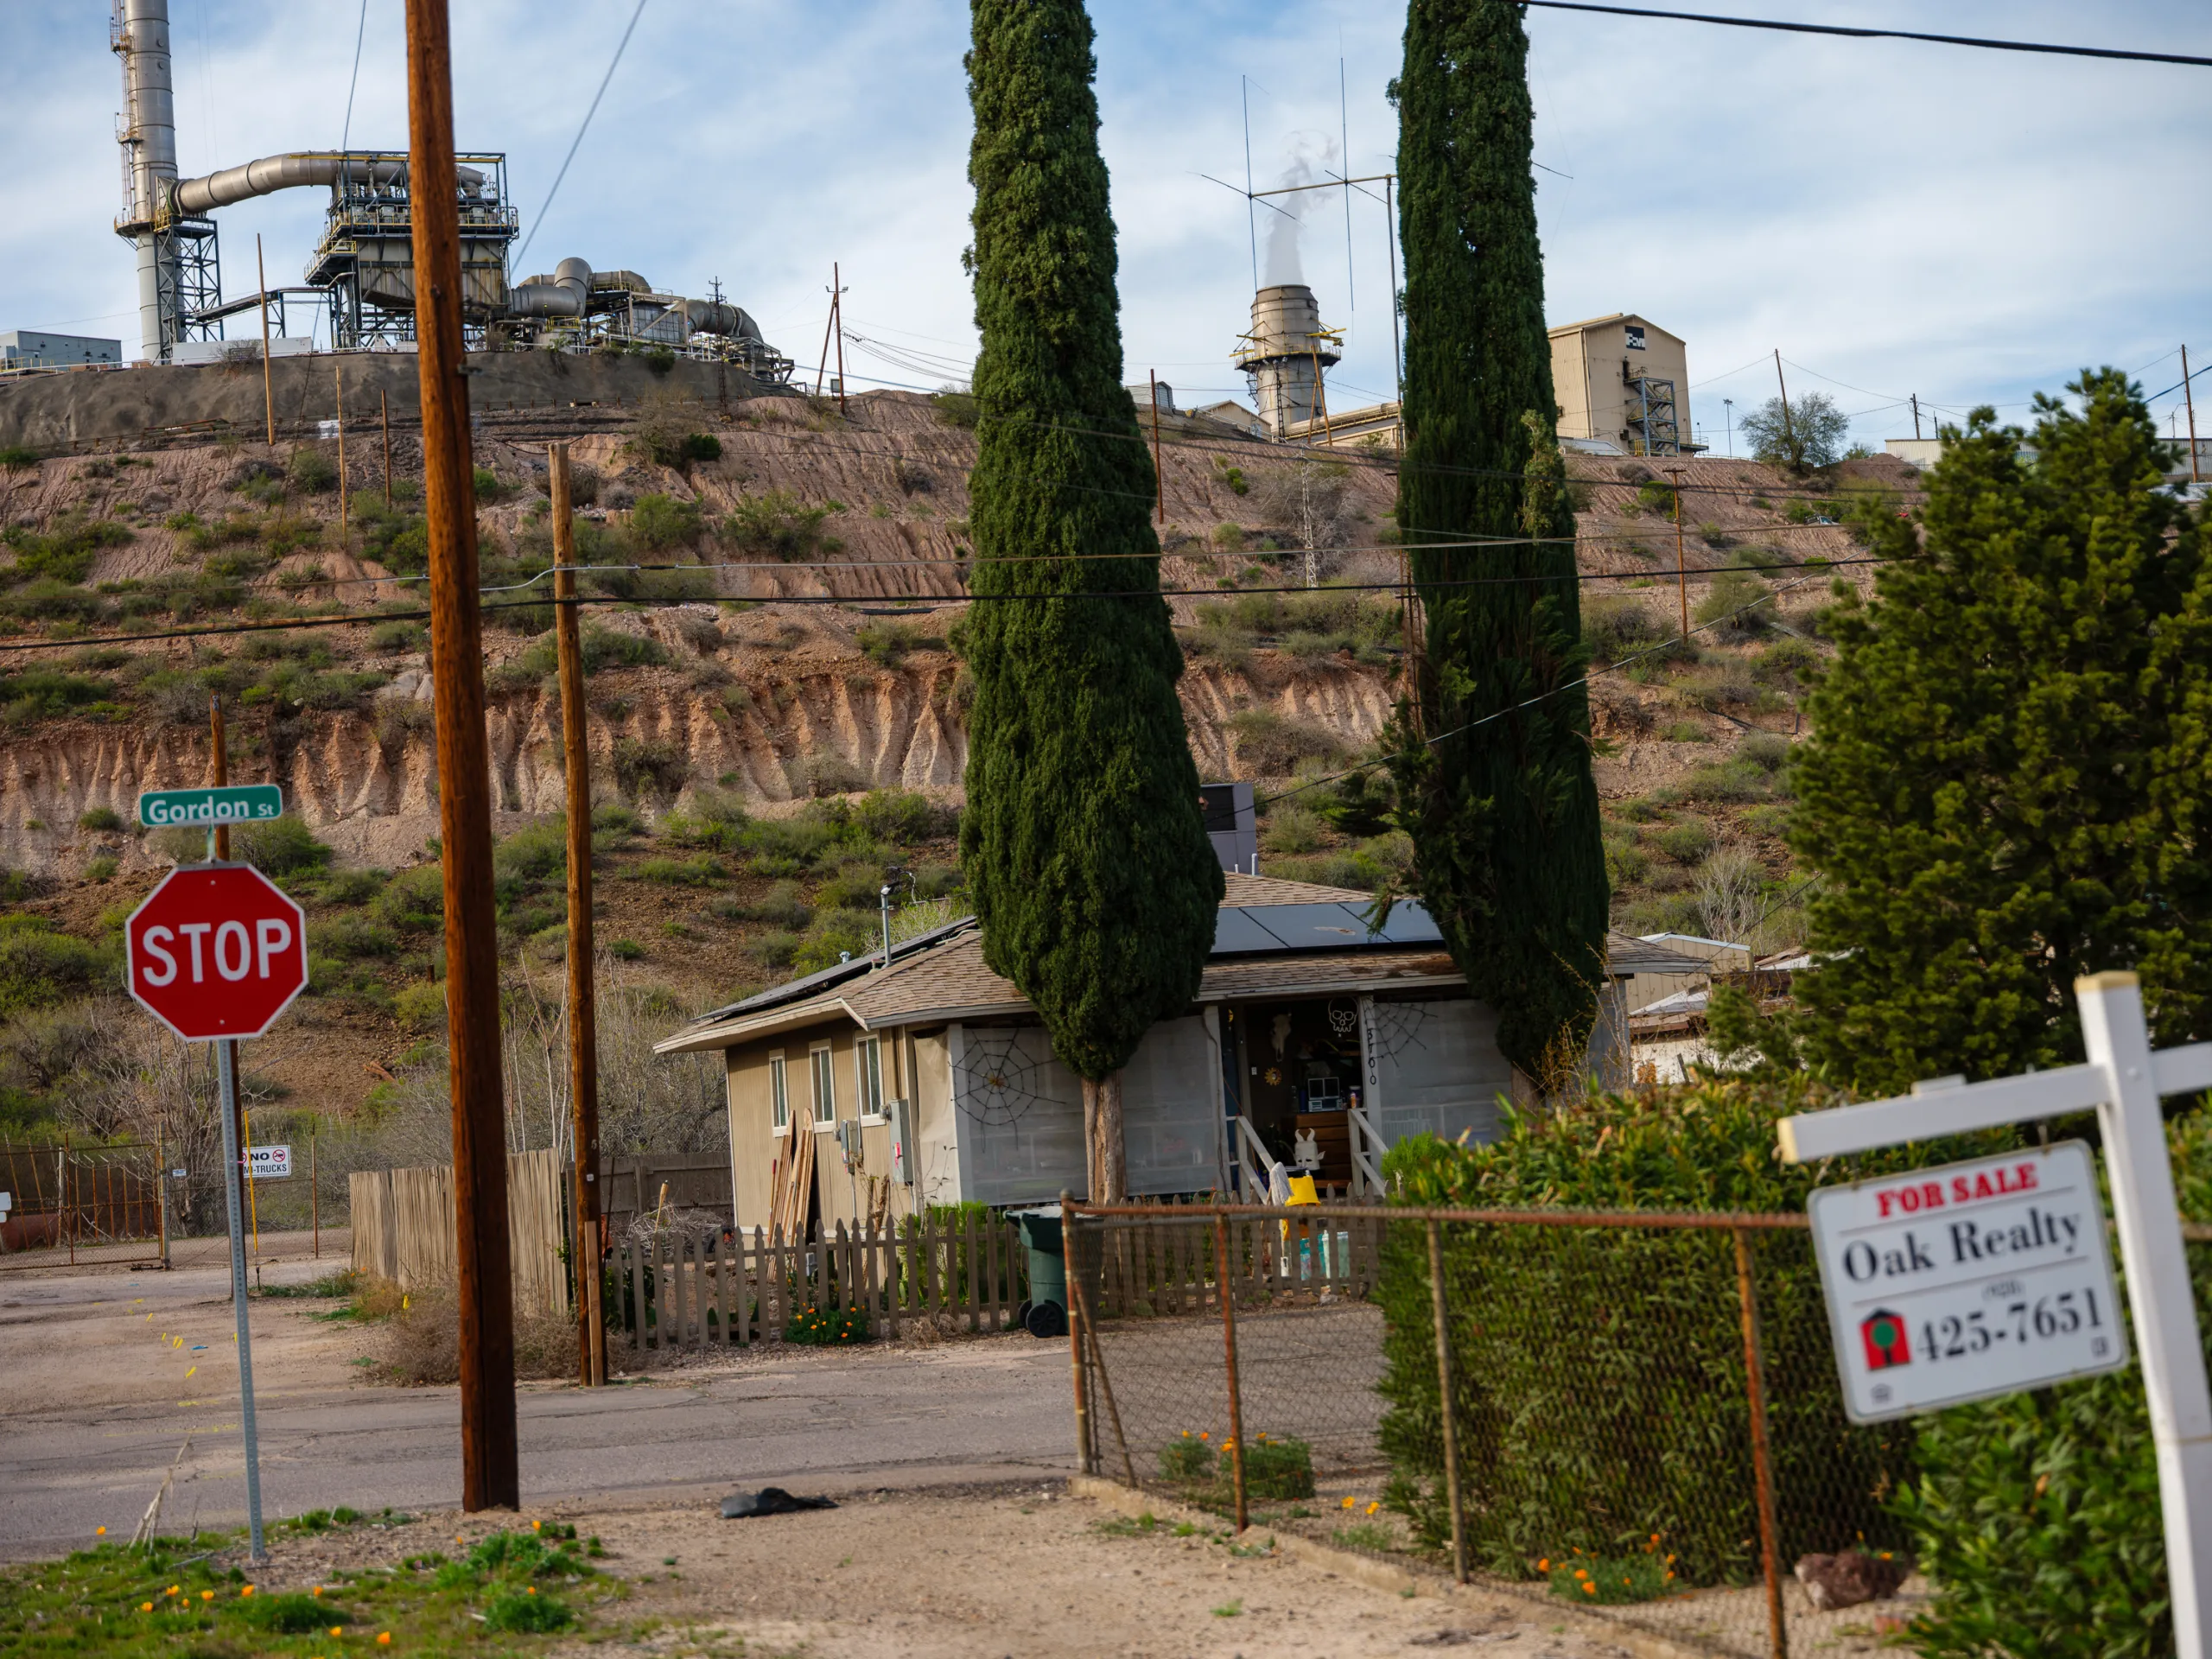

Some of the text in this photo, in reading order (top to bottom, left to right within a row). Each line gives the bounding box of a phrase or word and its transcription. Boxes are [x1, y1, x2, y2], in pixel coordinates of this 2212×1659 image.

[149, 796, 274, 823] Gordon St
[143, 918, 291, 987] STOP
[244, 1164, 287, 1174] MI-TRUCKS
[1875, 1162, 2039, 1218] FOR SALE
[1843, 1207, 2082, 1283] Oak Realty
[1917, 1287, 2103, 1362] 425-7651
